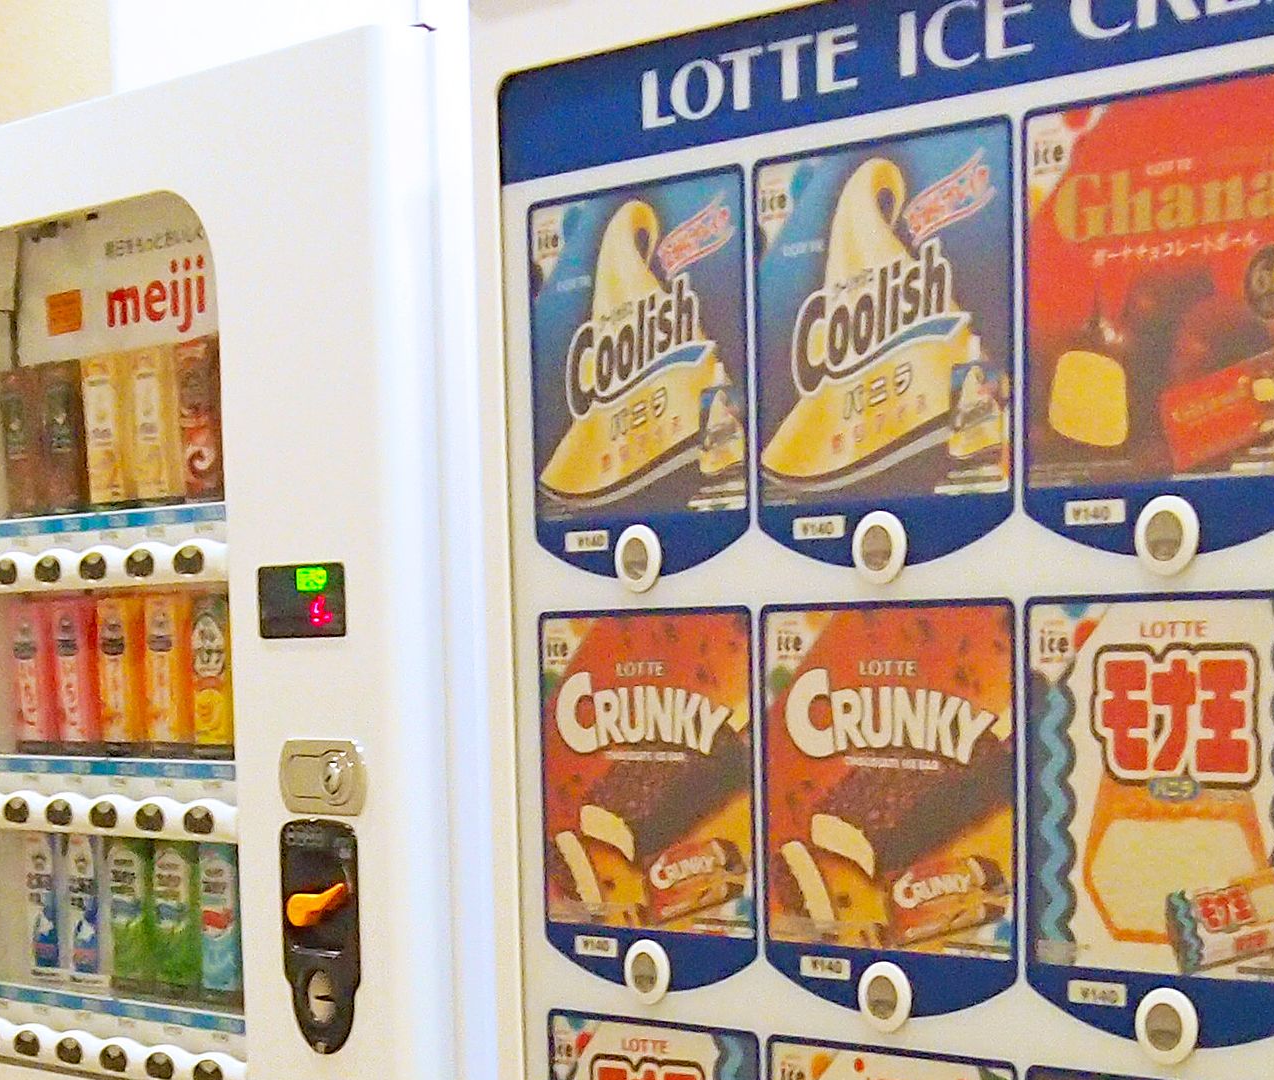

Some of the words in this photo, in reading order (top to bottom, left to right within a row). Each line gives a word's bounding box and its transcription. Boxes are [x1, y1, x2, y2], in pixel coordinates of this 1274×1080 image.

[640, 24, 858, 130] LOTTE
[899, 0, 1035, 78] ICE
[1034, 142, 1064, 167] ice
[760, 189, 787, 211] ice
[107, 254, 206, 333] meiji
[794, 240, 948, 396] Coolish
[568, 275, 697, 417] Coolish
[843, 361, 912, 420] バニラ
[609, 386, 668, 442] バニラ
[801, 521, 834, 536] ¥140
[1072, 505, 1111, 521] ¥140
[1039, 629, 1069, 655] ice
[1139, 620, 1208, 638] LOTTE
[615, 661, 666, 678] LOTTE
[858, 659, 917, 677] LOTTE
[555, 671, 731, 755] CRUNKY
[785, 667, 997, 765] CRUNKY
[1101, 657, 1250, 772] モナ王
[893, 870, 974, 909] CRUNKY
[621, 1038, 669, 1054] LOTTE
